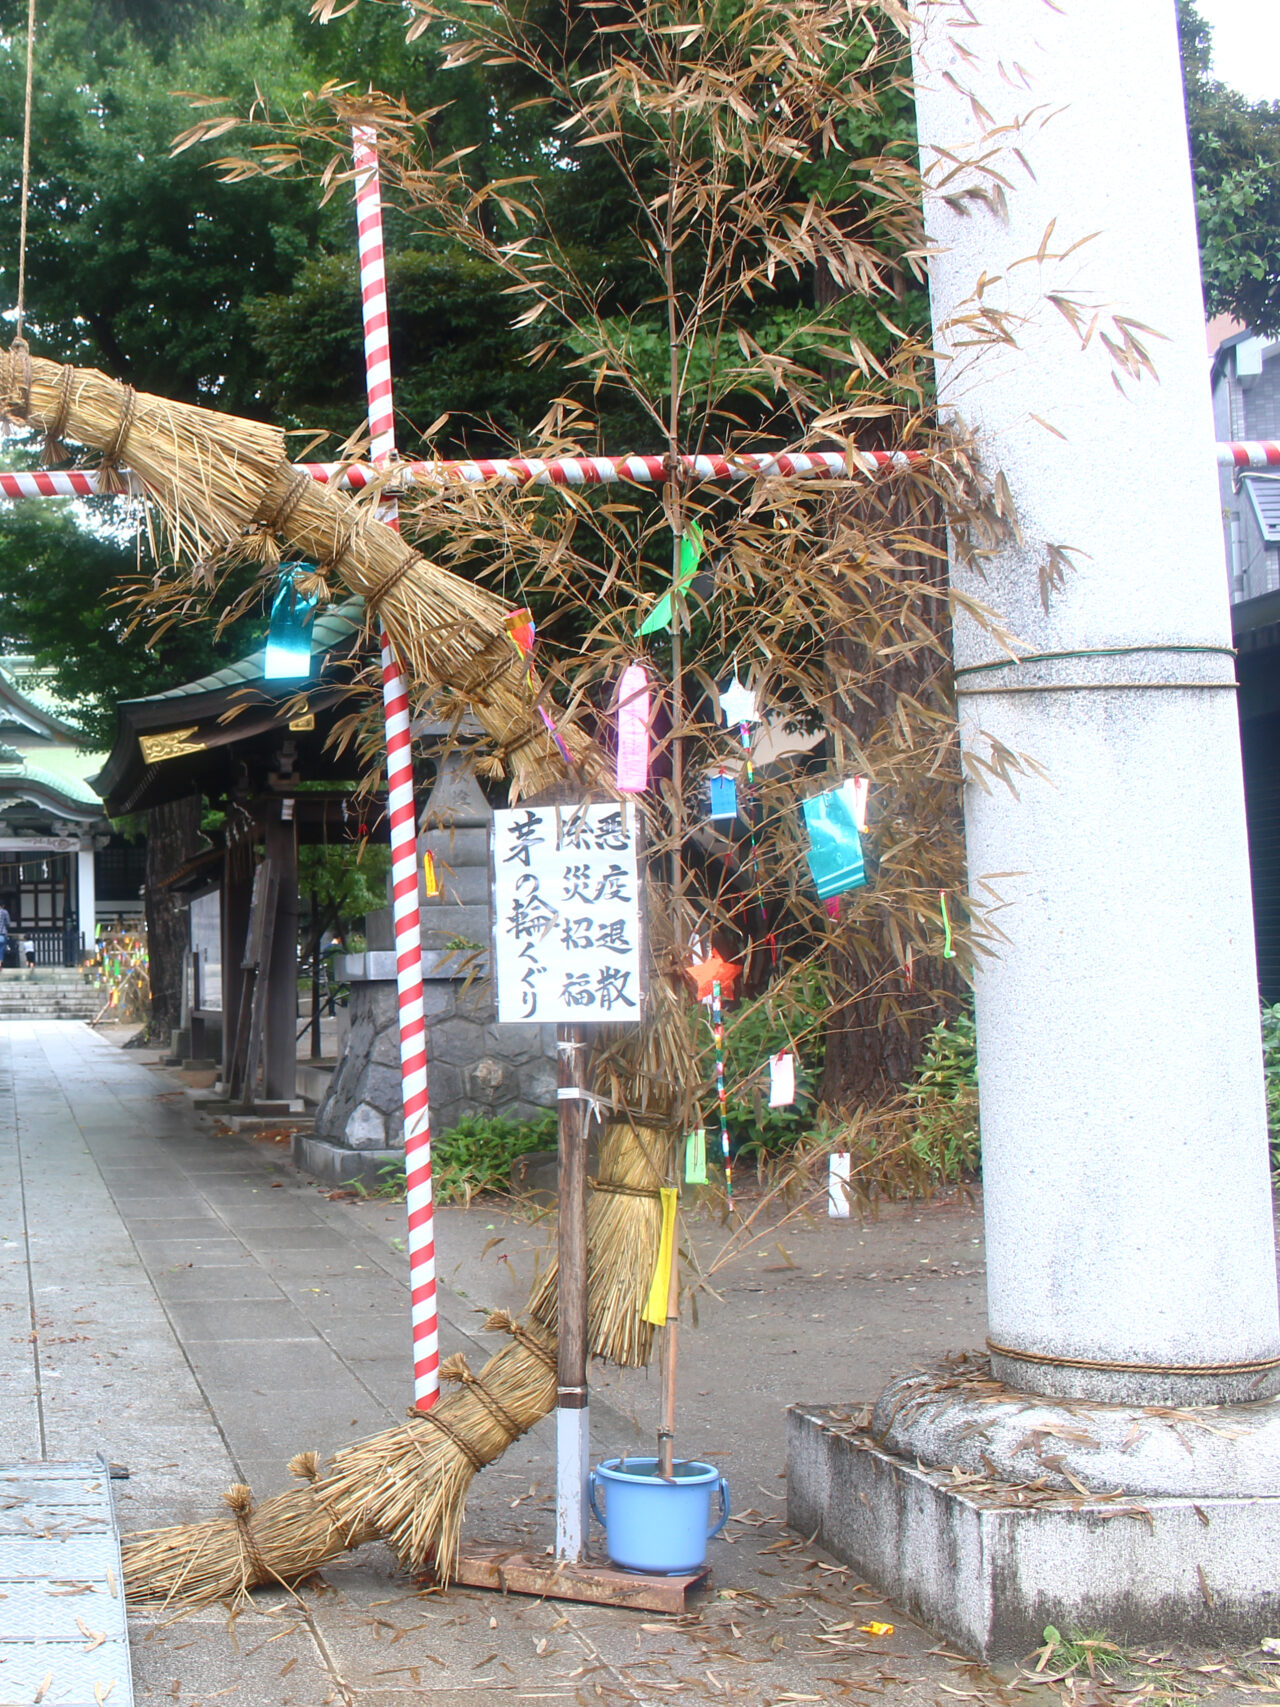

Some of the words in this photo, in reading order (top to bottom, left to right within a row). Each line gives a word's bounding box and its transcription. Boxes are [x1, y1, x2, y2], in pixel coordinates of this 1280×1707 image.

[502, 810, 561, 1019] 茅の輪くぐり
